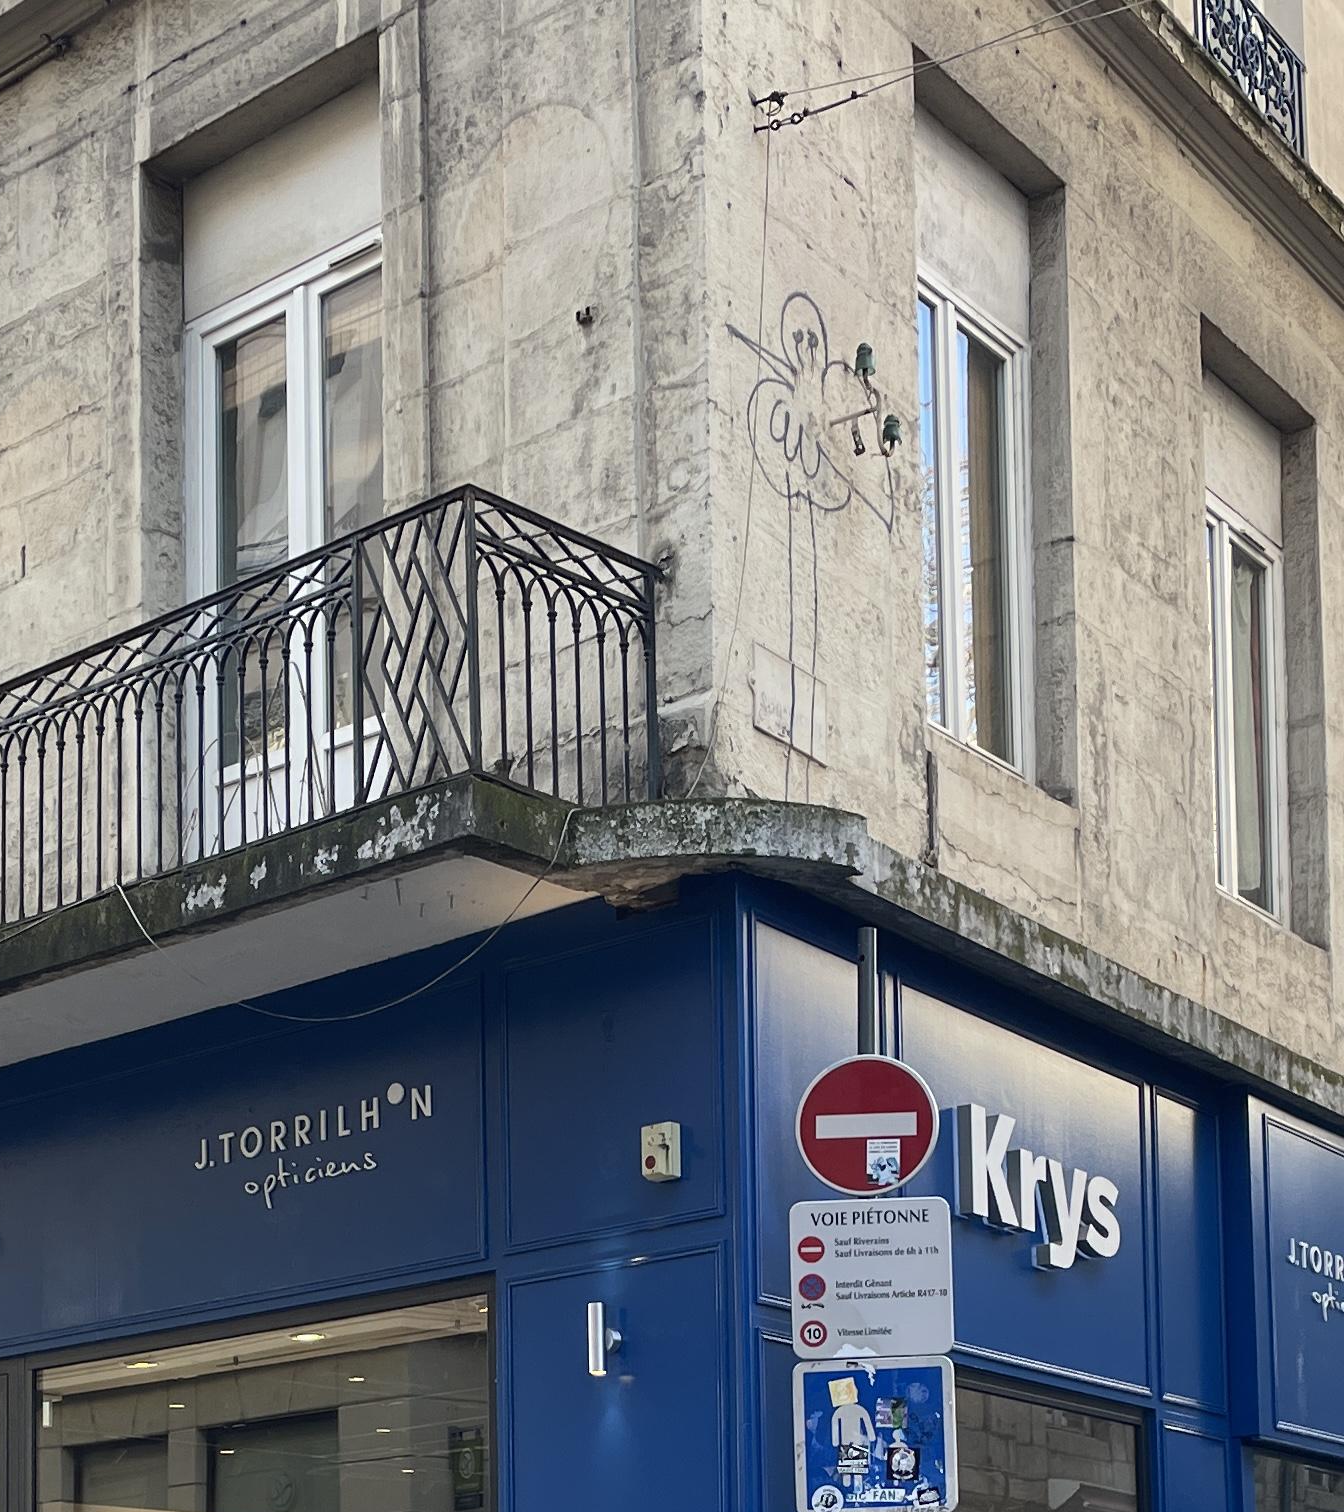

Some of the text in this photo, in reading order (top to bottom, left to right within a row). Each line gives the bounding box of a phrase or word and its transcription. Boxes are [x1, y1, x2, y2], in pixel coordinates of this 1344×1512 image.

[244, 1151, 378, 1208] opticiens
[957, 1103, 1121, 1270] Krys
[810, 1207, 930, 1227] VOIE PIÉTONNE
[834, 1236, 890, 1246] Sauf Riverains
[834, 1248, 852, 1258] Sauf
[853, 1247, 893, 1257] Livraisons
[895, 1247, 905, 1256] de
[925, 1245, 939, 1254] 11h
[835, 1279, 863, 1289] Interdit
[835, 1290, 852, 1300] Sauf
[853, 1289, 890, 1299] Livraisons
[891, 1287, 916, 1298] Article
[806, 1326, 822, 1340] 10
[836, 1325, 892, 1336] Vitesse Limitée
